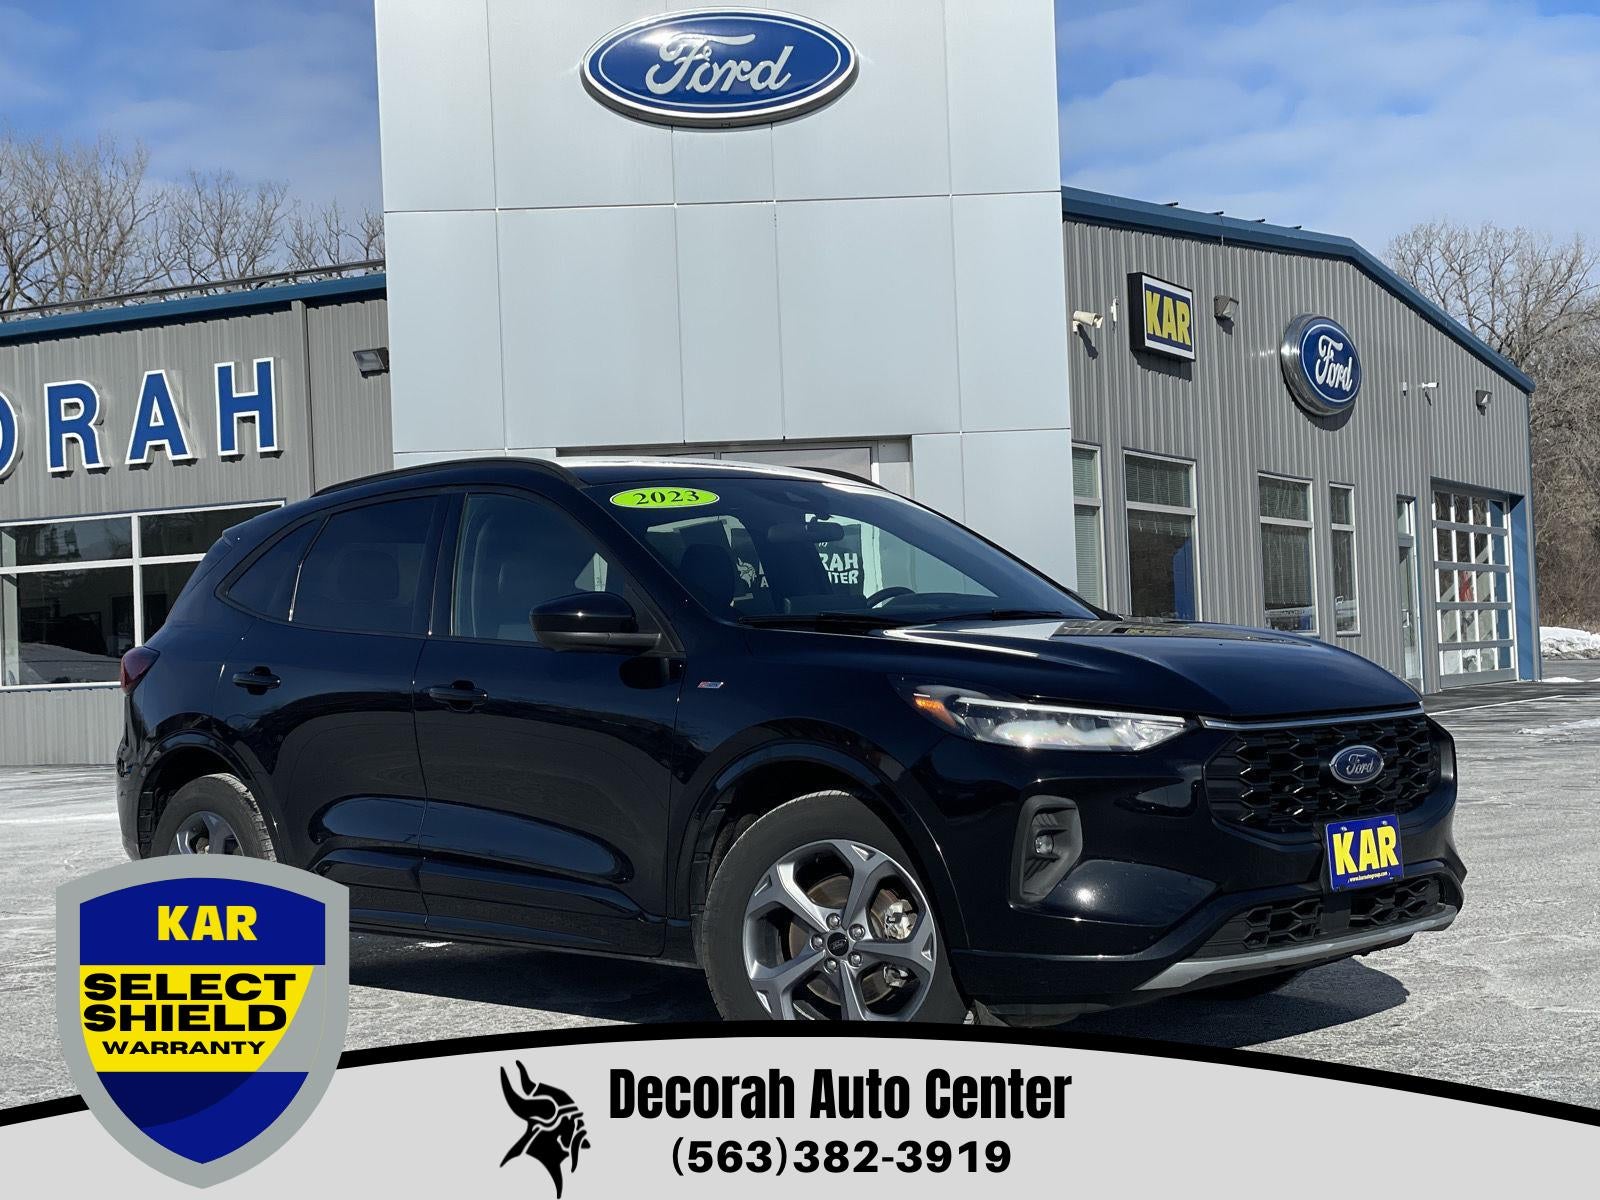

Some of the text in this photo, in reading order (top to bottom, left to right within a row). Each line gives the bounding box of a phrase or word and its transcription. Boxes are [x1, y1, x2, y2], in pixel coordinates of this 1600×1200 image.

[645, 33, 794, 95] Ford
[1145, 290, 1192, 346] KAR
[1315, 335, 1353, 392] Ford
[633, 490, 699, 505] 2023
[1346, 753, 1374, 775] Ford
[1333, 826, 1399, 875] KAR
